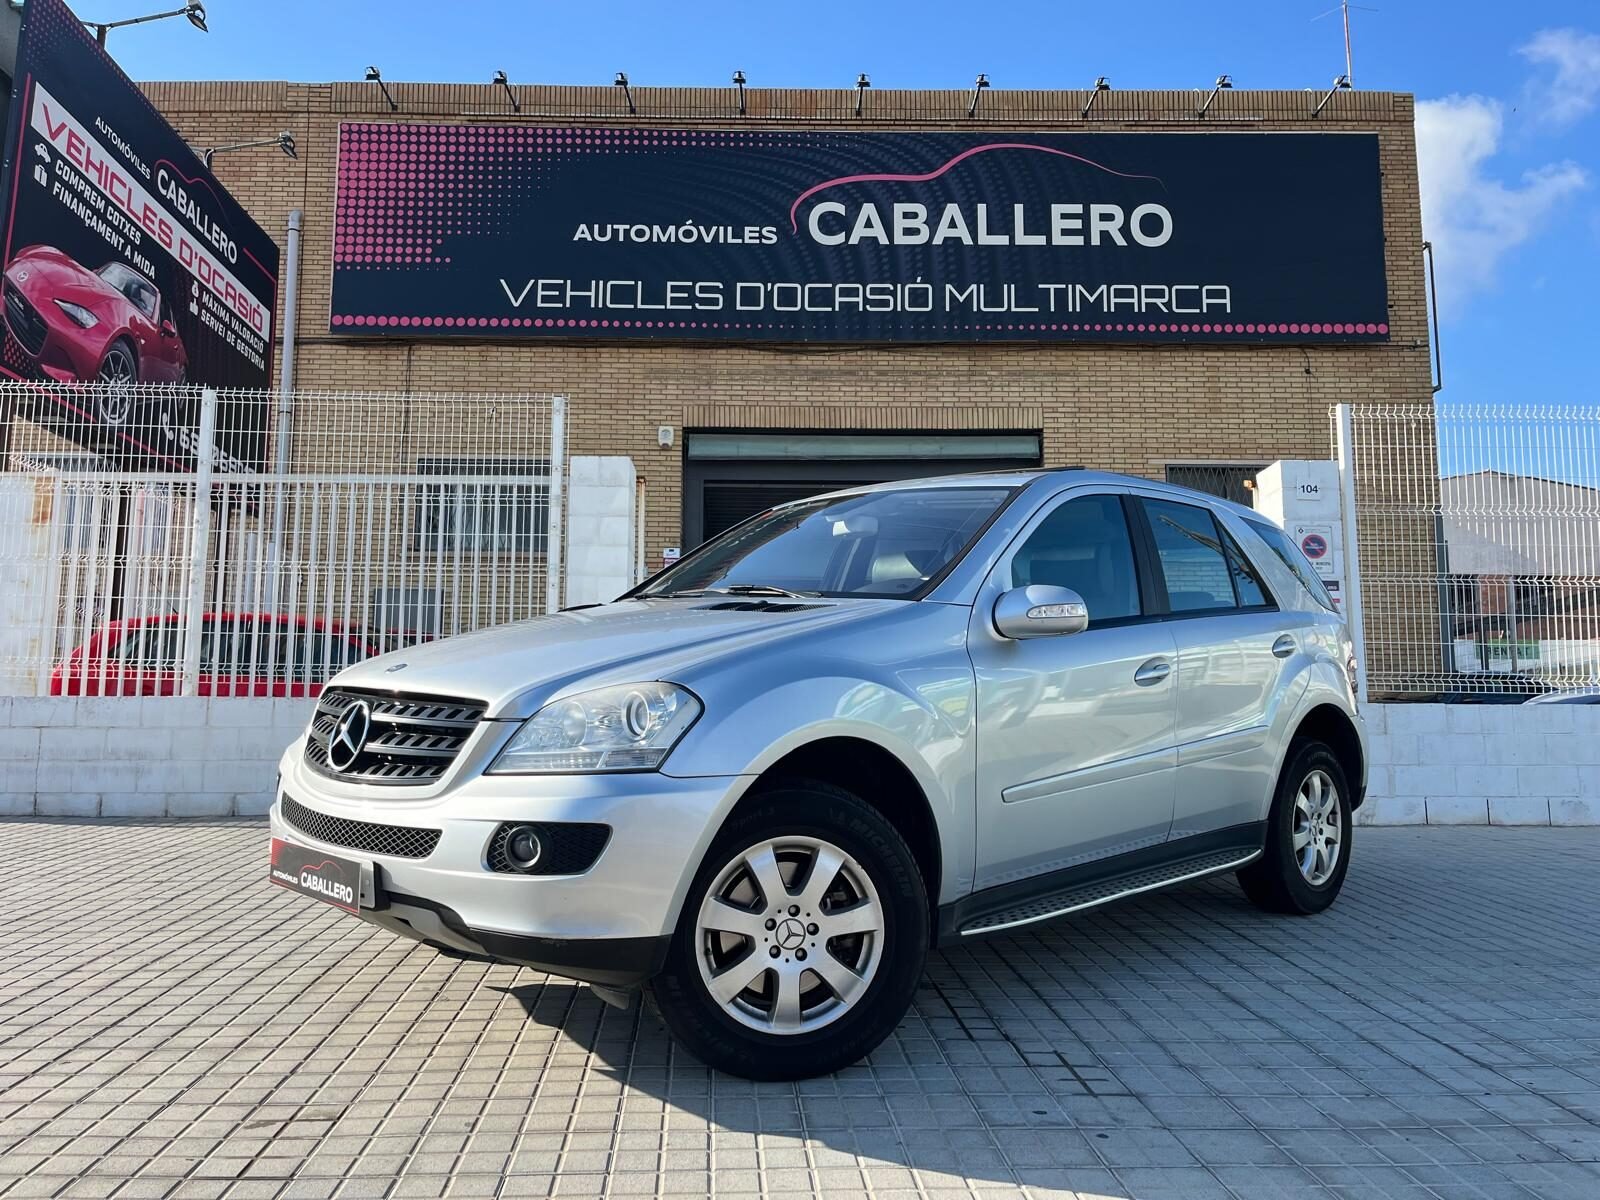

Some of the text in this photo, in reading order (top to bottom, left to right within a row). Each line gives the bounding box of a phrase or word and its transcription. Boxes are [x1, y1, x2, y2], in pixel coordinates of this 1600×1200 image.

[42, 102, 264, 333] VEHICLES D'OCASIÓ
[55, 159, 142, 246] COMPREM COTXES
[95, 116, 238, 265] AUTOMÓVILES CABALLERO
[52, 181, 156, 280] FINANÇAMENT A MIDA
[573, 201, 1173, 247] AUTOMÓVILES CABALLERO
[202, 291, 264, 354] MÀXIMA VALORACIÓ
[499, 276, 1231, 313] VEHICLES D'OCASIÓ MULTIMARCA
[200, 309, 265, 371] SERVEI DE GESTORIA
[1300, 485, 1318, 494] 104
[300, 871, 354, 904] CABALLERO
